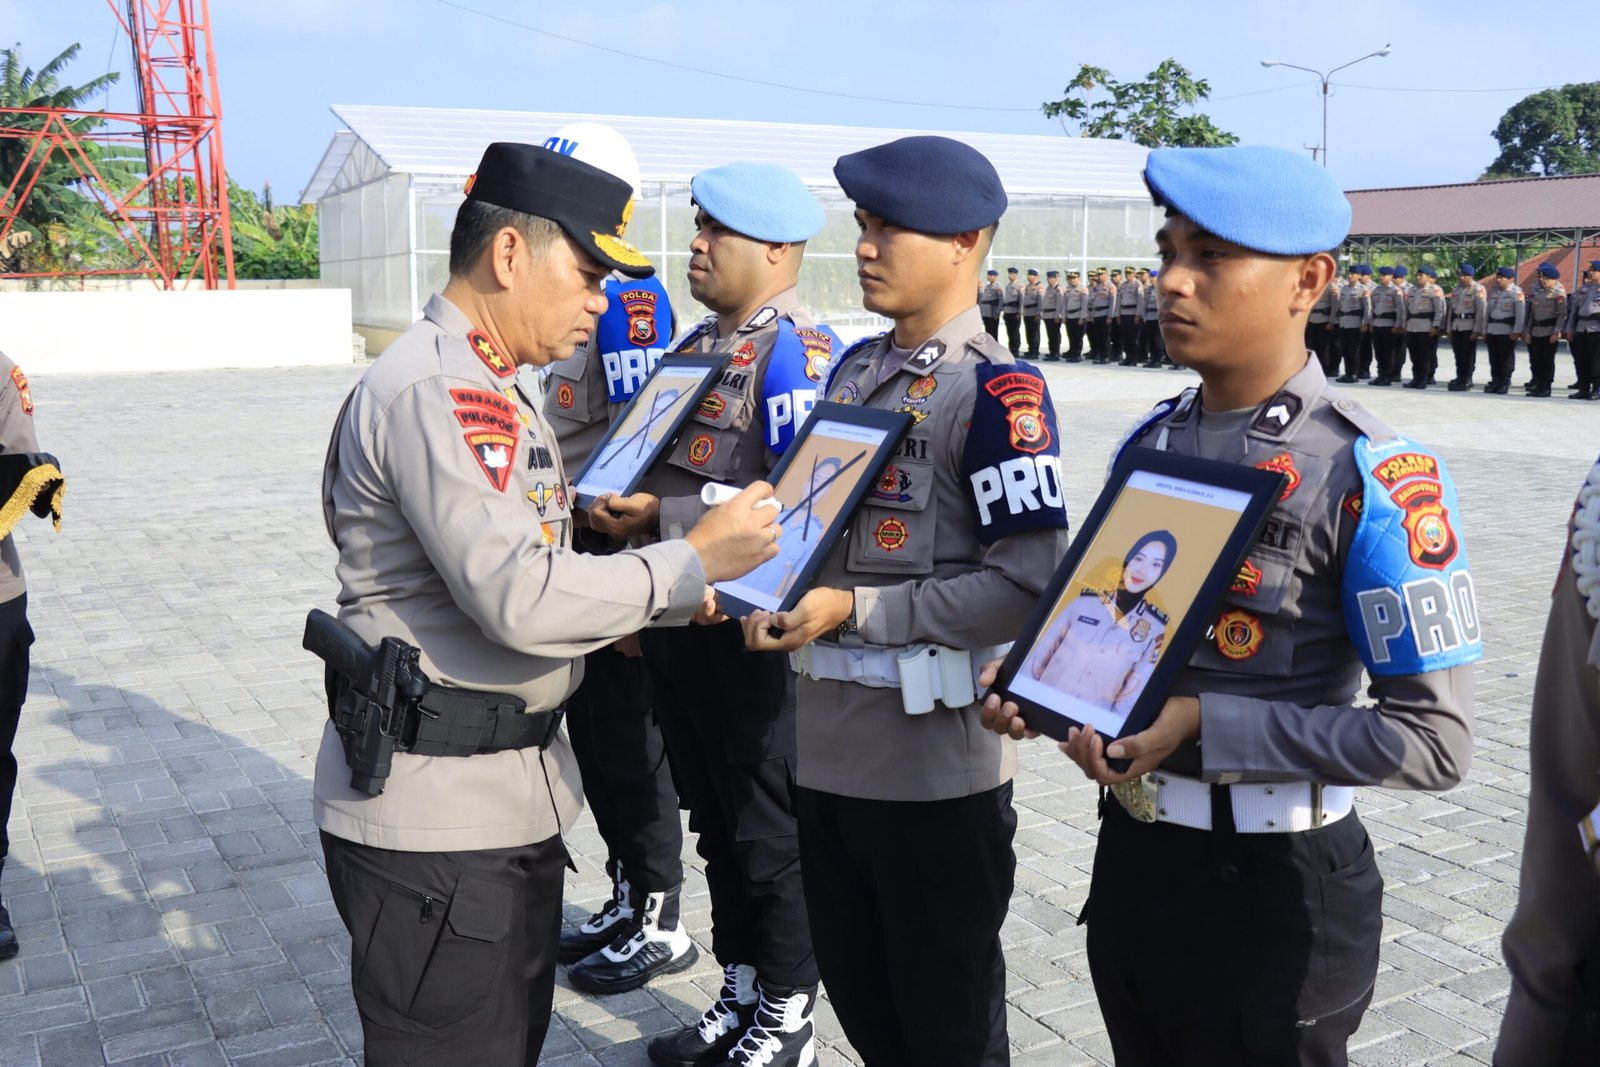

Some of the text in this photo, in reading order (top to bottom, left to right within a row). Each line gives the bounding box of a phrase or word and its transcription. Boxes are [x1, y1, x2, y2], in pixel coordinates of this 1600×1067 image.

[622, 292, 655, 302] POLDA
[716, 370, 748, 391] LRI
[896, 438, 928, 460] RI
[1379, 456, 1434, 480] POLRES
[1390, 464, 1431, 481] TERNATE
[1357, 569, 1481, 664] PRO
